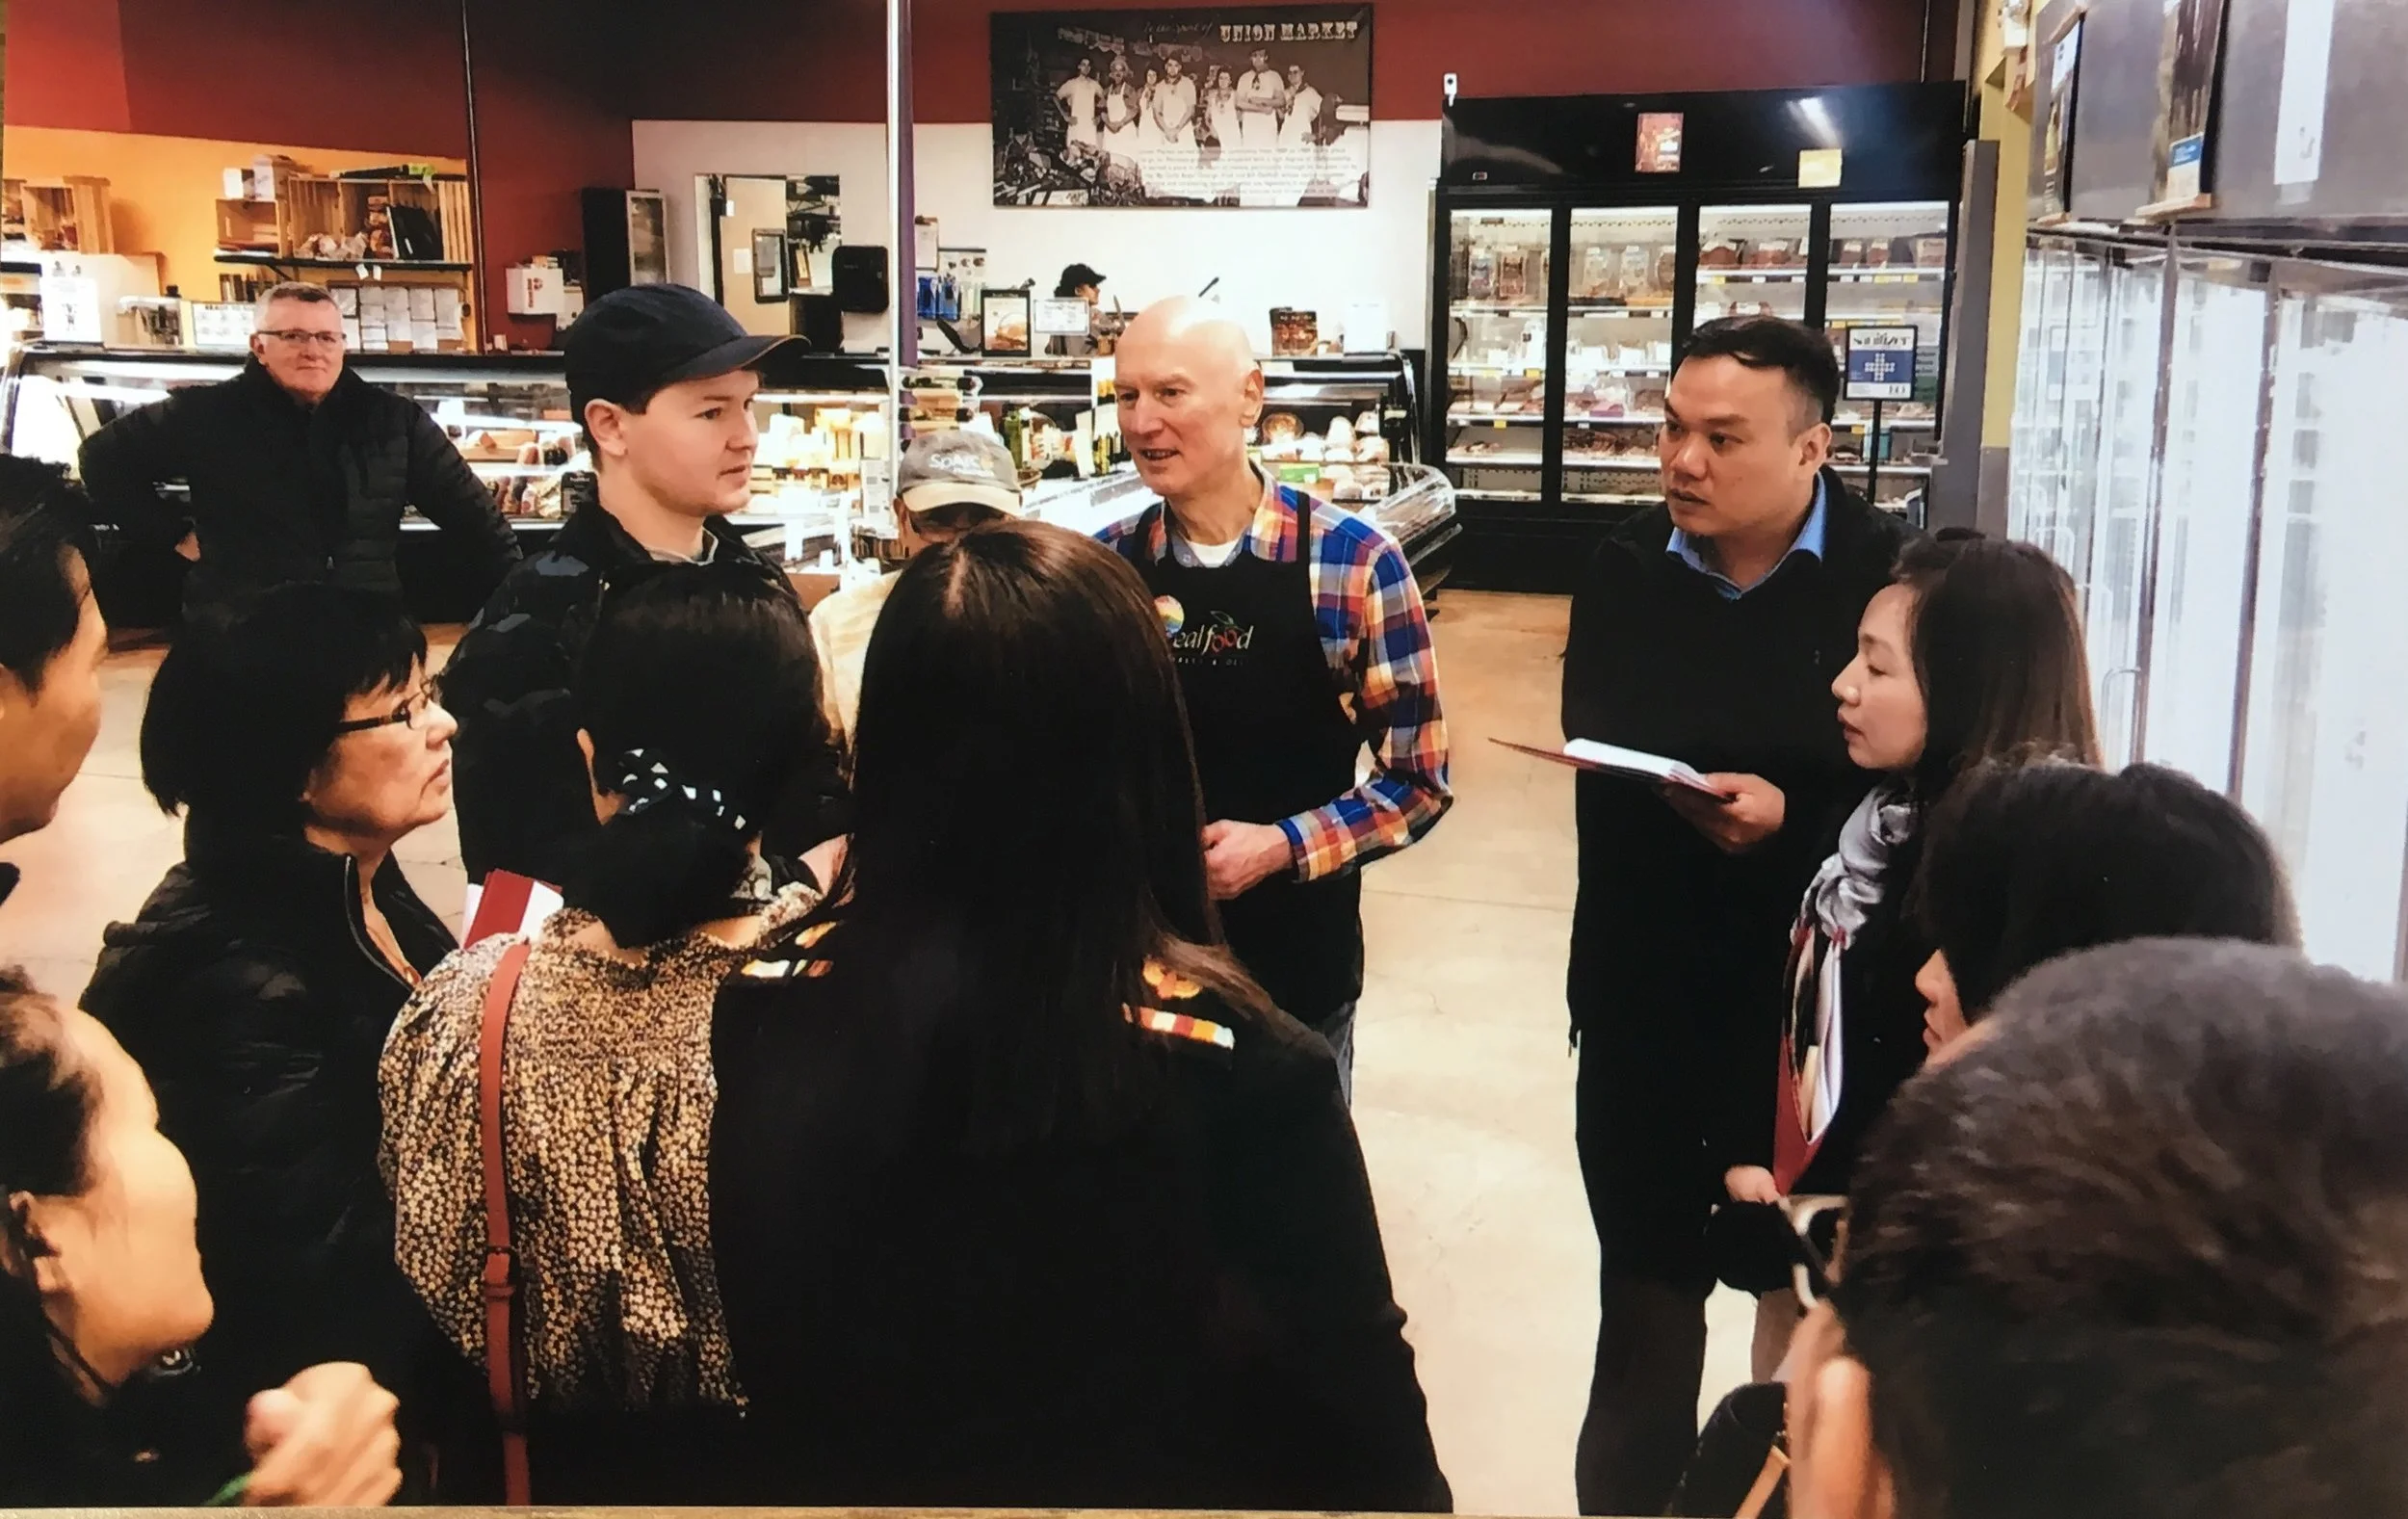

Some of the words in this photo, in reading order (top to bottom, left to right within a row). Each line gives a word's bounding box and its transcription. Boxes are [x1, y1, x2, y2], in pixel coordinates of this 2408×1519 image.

[1219, 24, 1275, 42] UNION
[1281, 21, 1358, 40] MARKET
[1171, 624, 1255, 656] ealfood
